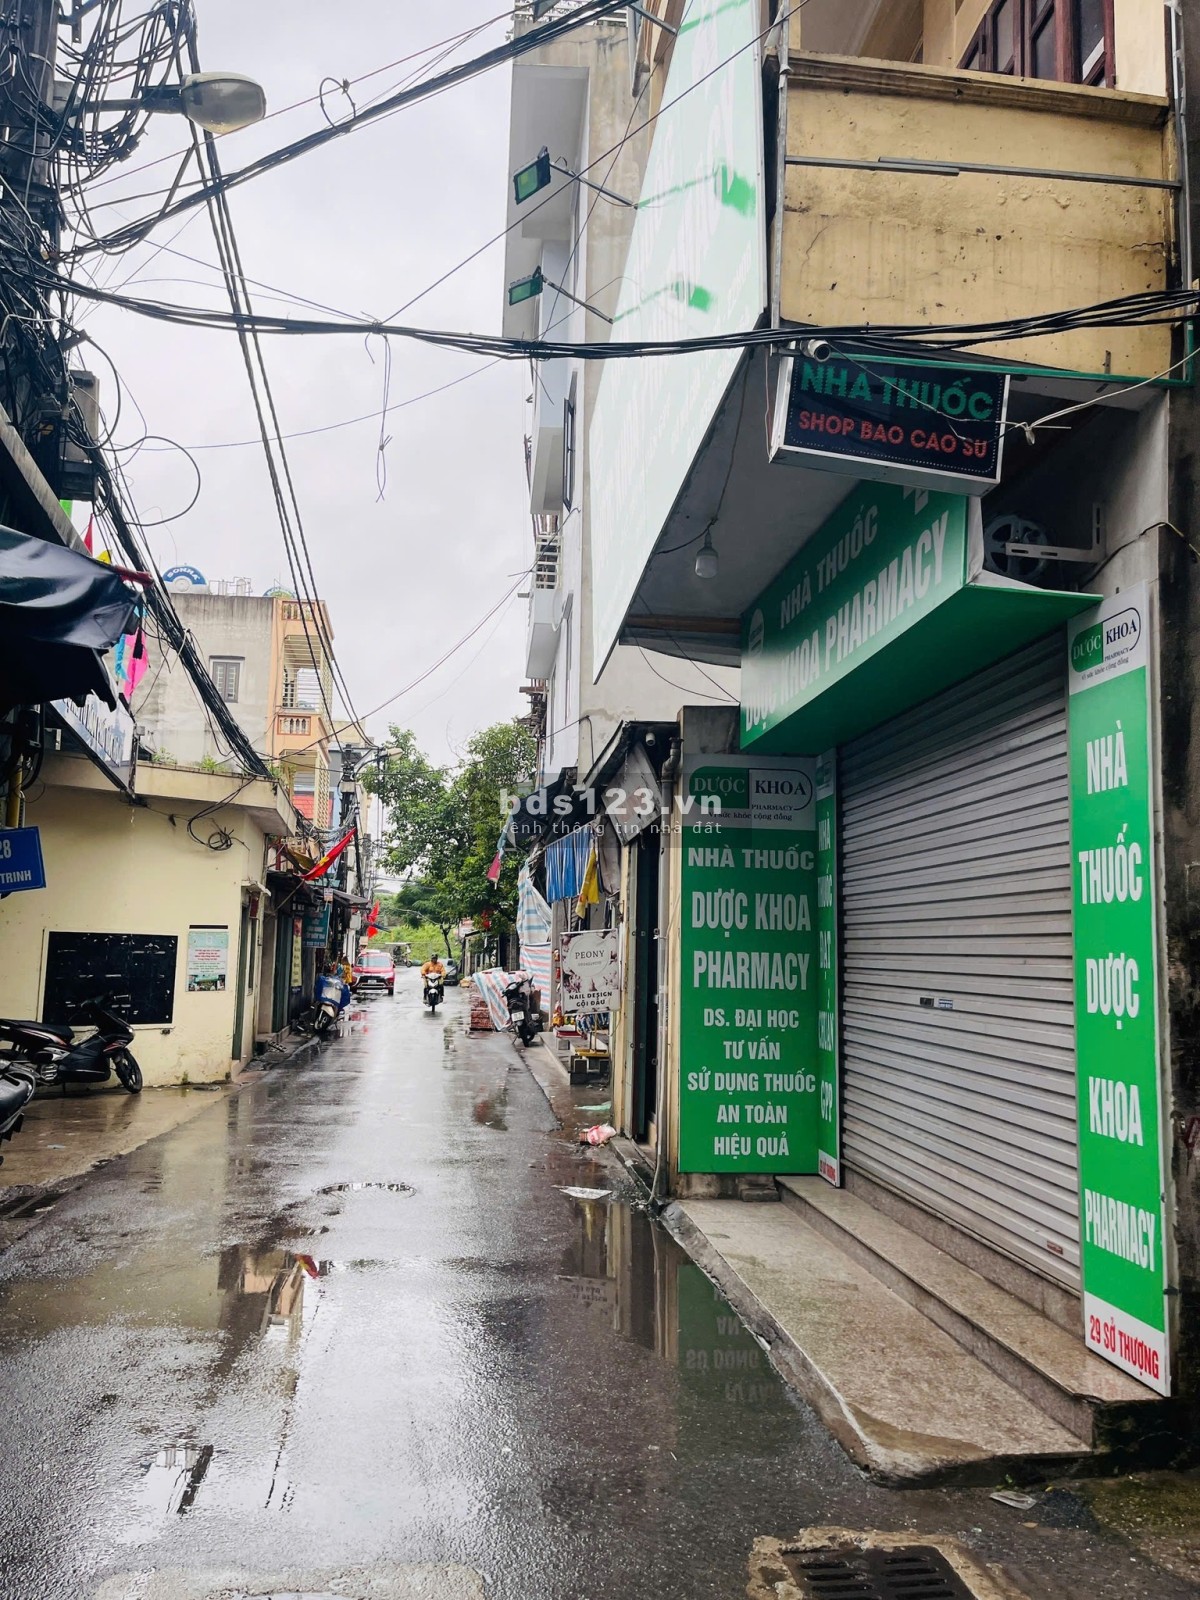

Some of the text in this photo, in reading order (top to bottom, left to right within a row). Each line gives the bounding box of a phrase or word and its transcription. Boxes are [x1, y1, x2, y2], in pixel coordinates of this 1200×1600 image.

[881, 375, 994, 420] THUỐC
[799, 410, 988, 459] SHOP BAO CAO SU
[780, 504, 878, 630] NHÀ THUỐC
[780, 629, 820, 706] KHOA
[824, 510, 949, 672] PHARMACY
[1073, 618, 1138, 660] DƯỢC KHOA
[1086, 719, 1129, 795] NHÀ
[694, 776, 806, 797] DƯỢC KHOA
[751, 803, 794, 811] PHARMACY
[688, 843, 815, 871] NHÀ THUỐC
[1078, 822, 1143, 905] THUỐC
[691, 888, 812, 938] DƯỢC KHOA
[575, 949, 605, 960] PEONY
[693, 950, 810, 991] PHARMACY
[569, 991, 613, 1000] NAIL DESIGN
[1085, 952, 1140, 1030] DƯỢC
[703, 1008, 799, 1032] DS. ĐẠI HỌC
[723, 1035, 781, 1060] TƯ VẤN
[687, 1066, 816, 1095] SỬ DỤNG THUỐC
[820, 1079, 833, 1123] GPP
[716, 1101, 788, 1124] AN TOÀN
[1088, 1075, 1144, 1147] KHOA
[714, 1131, 790, 1159] HIỆU QUẢ
[1084, 1187, 1156, 1273] PHARMACY
[1089, 1314, 1160, 1380] 29 SỞ THƯỢNG
